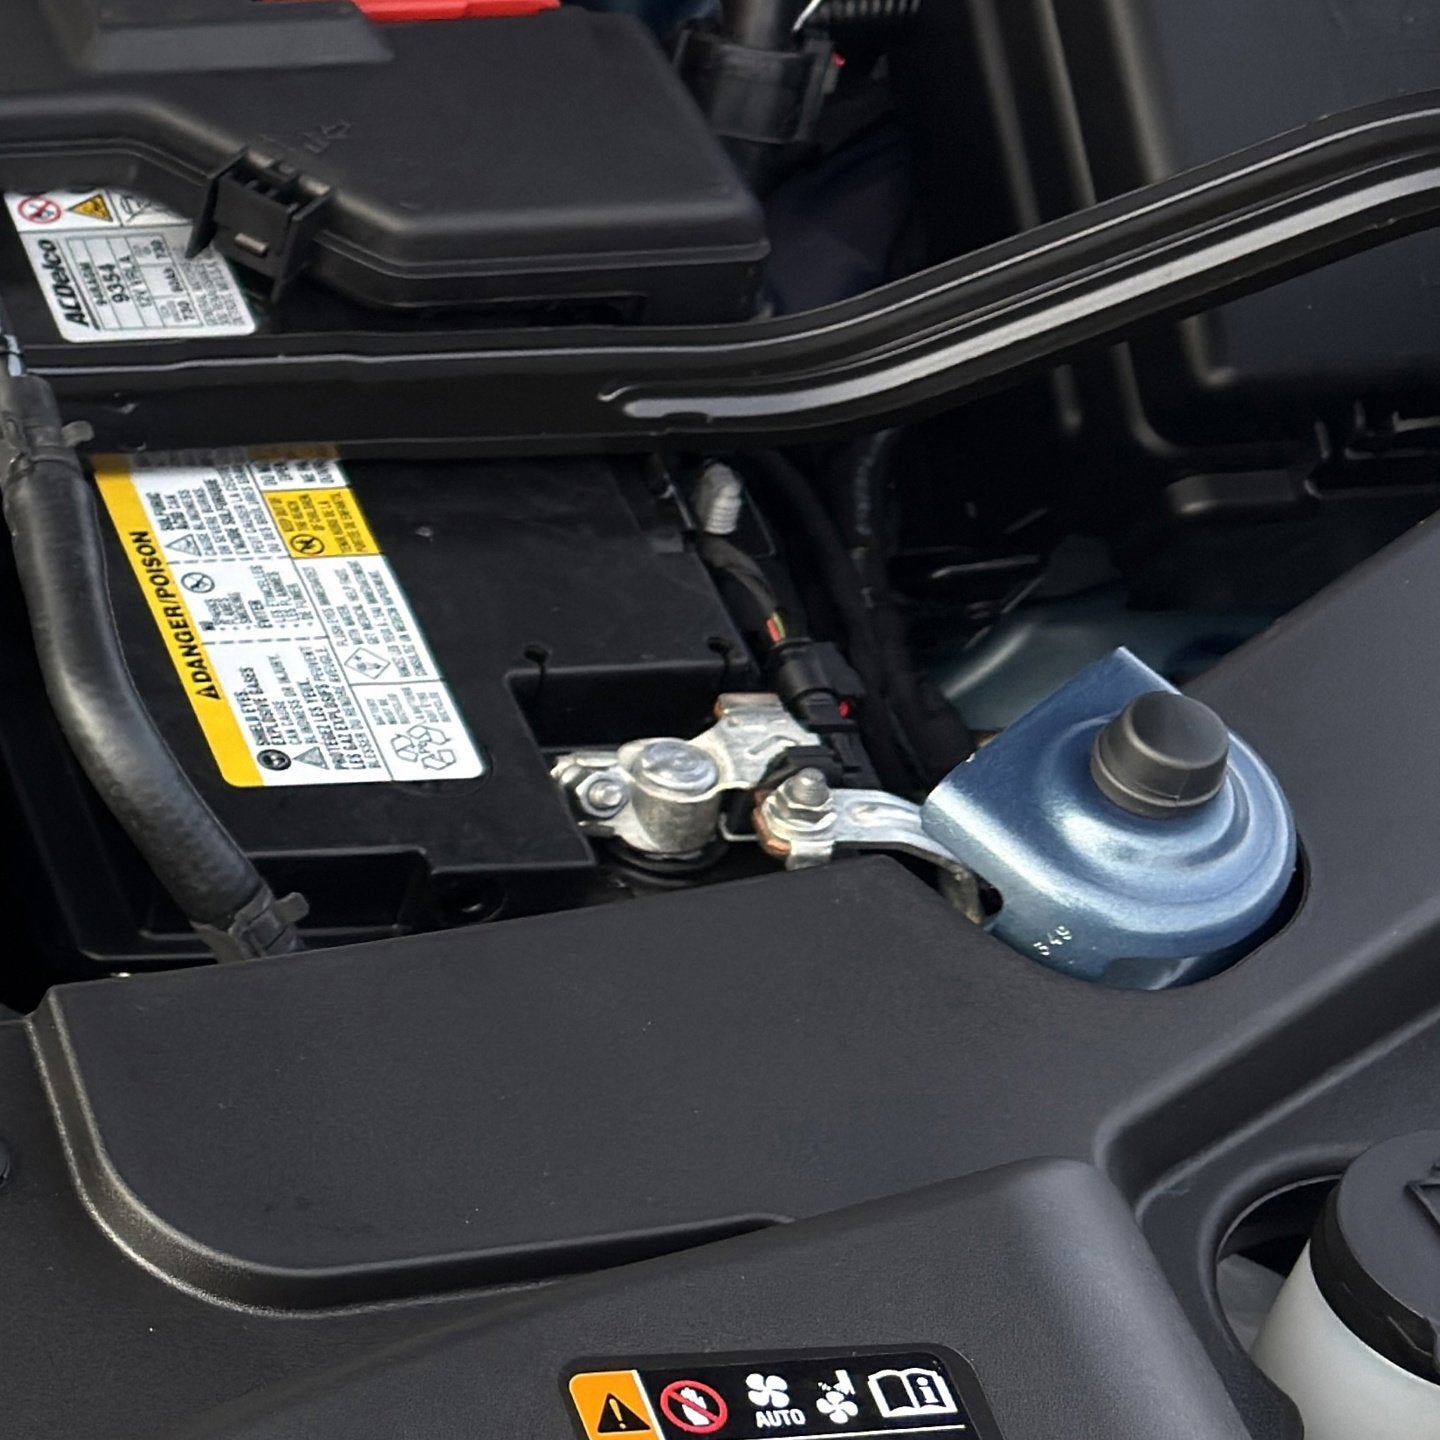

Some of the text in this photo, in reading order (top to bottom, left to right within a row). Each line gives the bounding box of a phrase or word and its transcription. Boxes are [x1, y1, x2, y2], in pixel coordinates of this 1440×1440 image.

[38, 239, 88, 326] ACDelco
[97, 264, 129, 303] 9354
[131, 531, 211, 682] DANGER/POISON
[755, 1407, 806, 1428] AUTO
